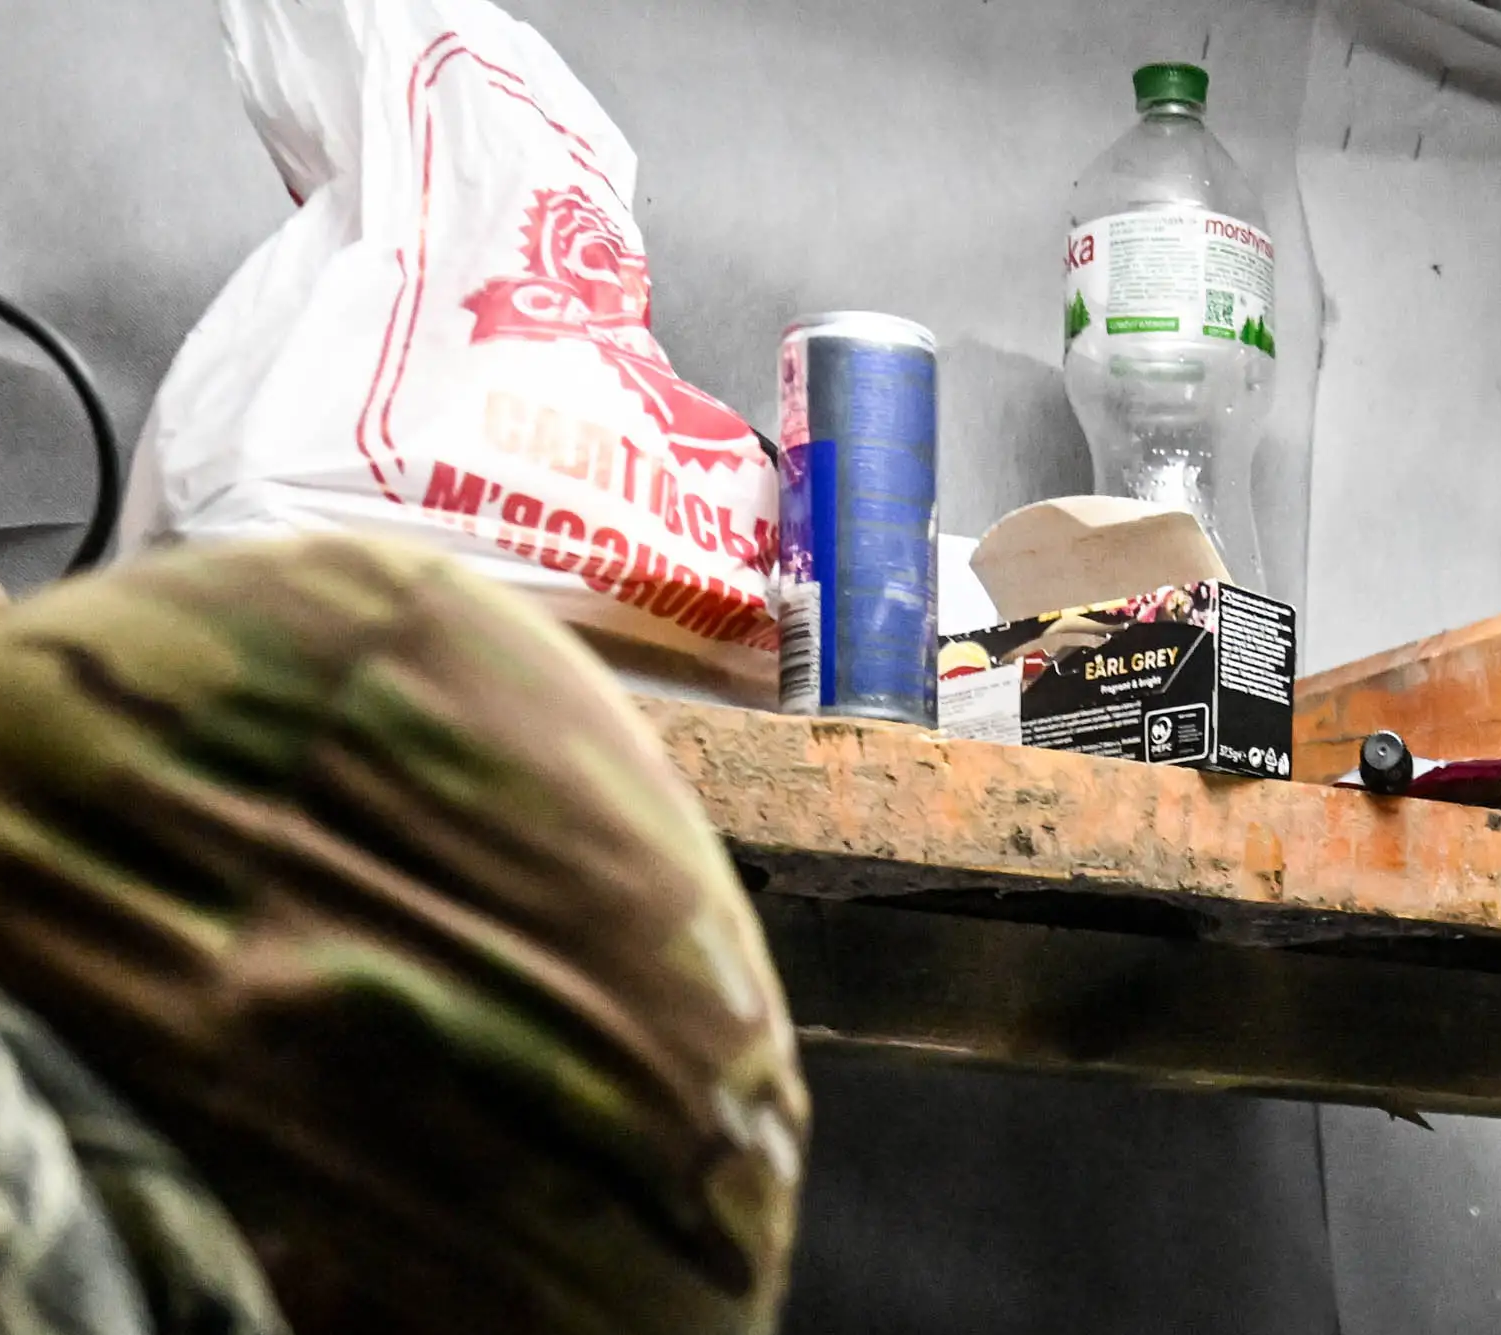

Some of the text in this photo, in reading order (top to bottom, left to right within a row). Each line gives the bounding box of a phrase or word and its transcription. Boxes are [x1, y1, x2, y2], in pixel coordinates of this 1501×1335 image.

[1062, 234, 1095, 274] ka
[1085, 646, 1179, 680] EARL GREY
